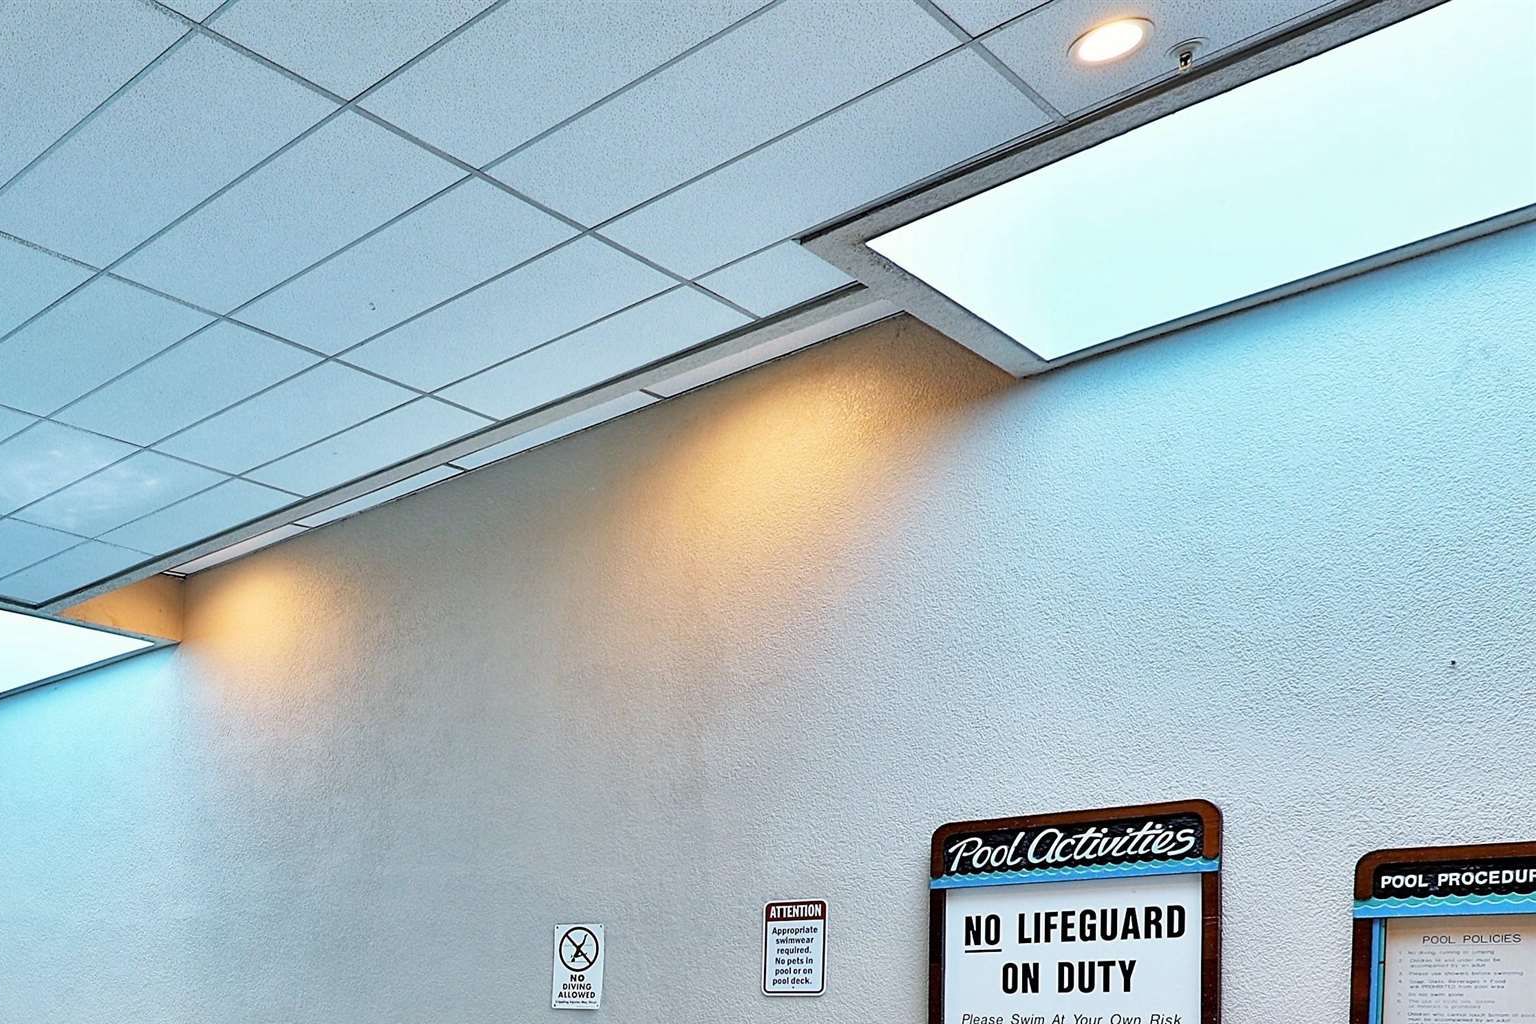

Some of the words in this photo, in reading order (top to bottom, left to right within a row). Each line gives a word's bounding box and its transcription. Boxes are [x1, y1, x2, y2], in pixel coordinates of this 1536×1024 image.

[949, 831, 1026, 871] Pool
[1028, 821, 1196, 864] Activities
[1381, 874, 1429, 889] POOL
[770, 903, 822, 918] ATTENTION
[964, 914, 1002, 947] NO
[1018, 904, 1186, 944] LIFEGUARD
[772, 926, 818, 936] Appropriate
[776, 936, 814, 944] swimwear
[1422, 935, 1456, 944] POOL
[1463, 934, 1522, 944] POLICIES
[777, 946, 812, 955] required.
[787, 957, 804, 966] pets
[775, 967, 792, 976] pool
[1001, 962, 1040, 994] ON
[1057, 959, 1136, 993] DUTY
[571, 974, 585, 982] NO
[772, 977, 790, 986] pool
[791, 976, 812, 984] deck.
[558, 991, 596, 999] ALLOWED
